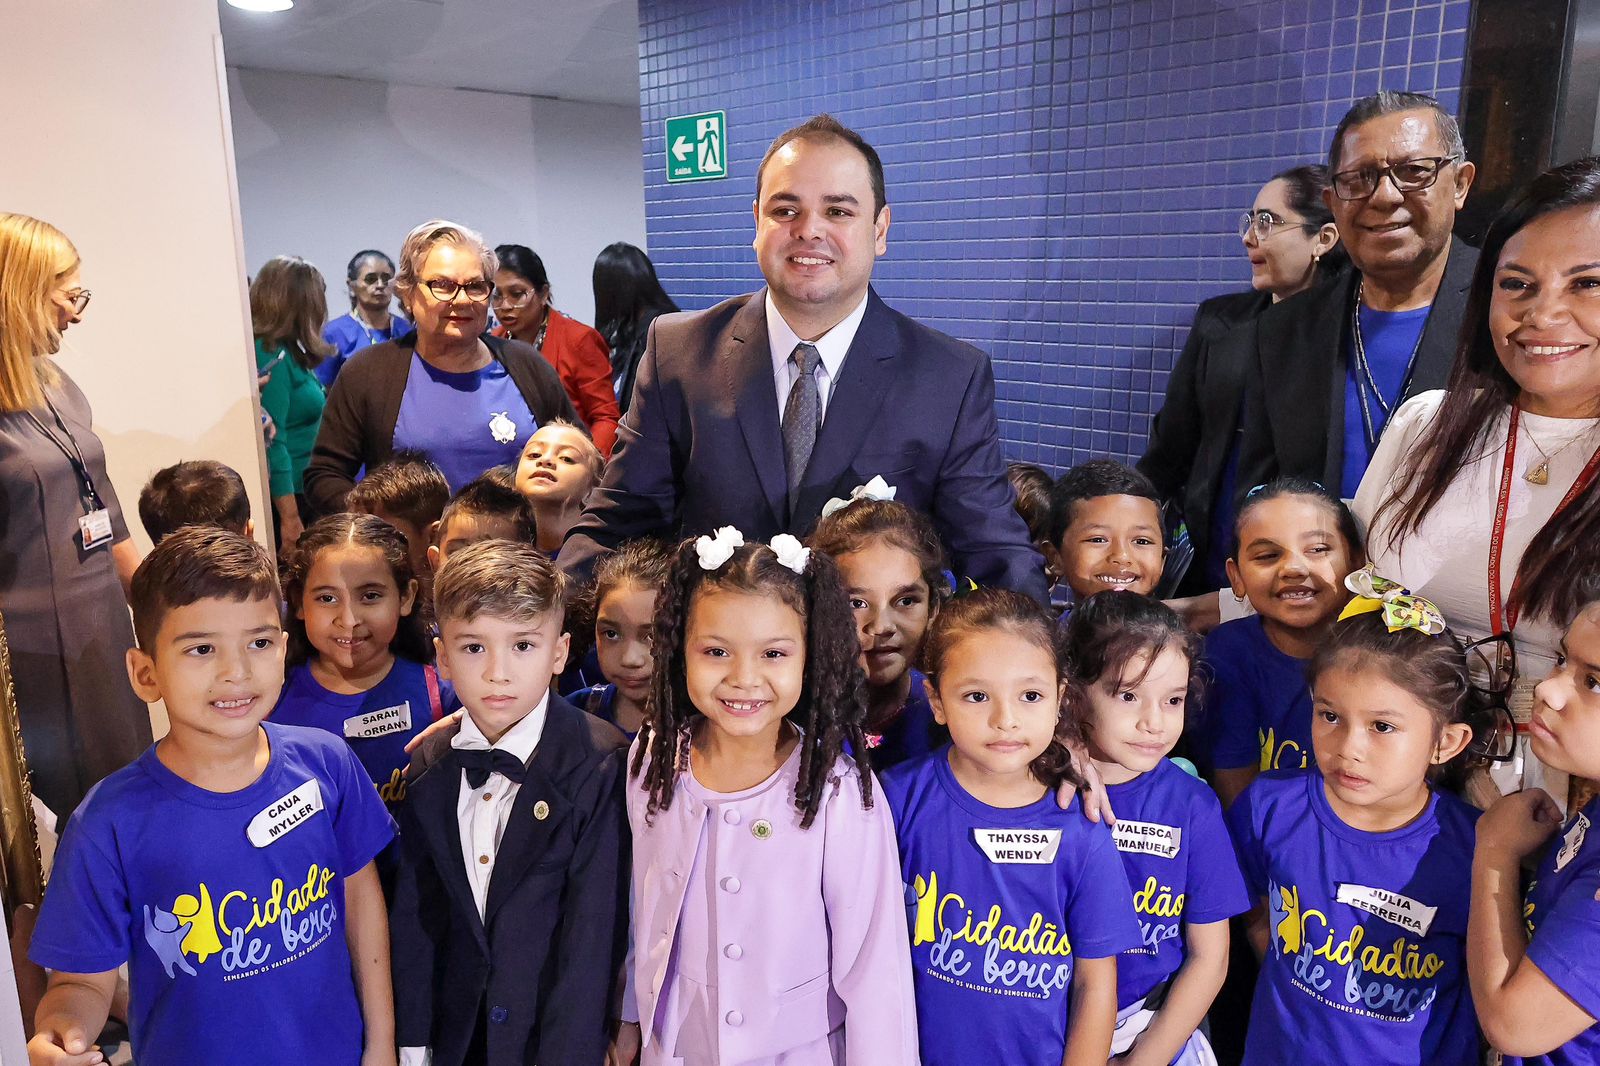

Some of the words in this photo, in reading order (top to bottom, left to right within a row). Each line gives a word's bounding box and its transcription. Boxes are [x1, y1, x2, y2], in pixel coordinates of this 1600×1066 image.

[1492, 536, 1498, 544] DO
[1490, 546, 1498, 568] ESTADO
[1488, 570, 1495, 579] DO
[358, 720, 408, 736] LORRANY
[362, 709, 399, 724] SARAH
[268, 794, 301, 818] CAUA
[268, 804, 314, 837] MYLLER
[1117, 824, 1173, 840] VALESCA
[987, 834, 1049, 844] THAYSSA
[994, 850, 1042, 860] WENDY
[1369, 889, 1412, 911] JULIA
[938, 893, 1072, 956] Cidadão
[1352, 898, 1422, 930] FERREIRA
[221, 926, 272, 972] de
[1301, 909, 1445, 980] Cidadão
[223, 969, 259, 982] SEMEANDO
[261, 964, 270, 972] OS
[272, 954, 298, 969] VALORES
[298, 950, 306, 958] DA
[930, 928, 972, 976] de
[983, 938, 1071, 1000] berço
[927, 968, 954, 985] SEMEANDO
[966, 982, 992, 994] VALORES
[1004, 990, 1042, 999] DEMOCRACIA
[1294, 942, 1332, 992] de
[1344, 958, 1437, 1022] berço
[1290, 978, 1316, 998] SEMEANDO
[1316, 994, 1324, 1002] OS
[1325, 999, 1354, 1014] VALORES
[1356, 1008, 1364, 1016] DA
[1366, 1011, 1406, 1022] DEMOCRACIA
